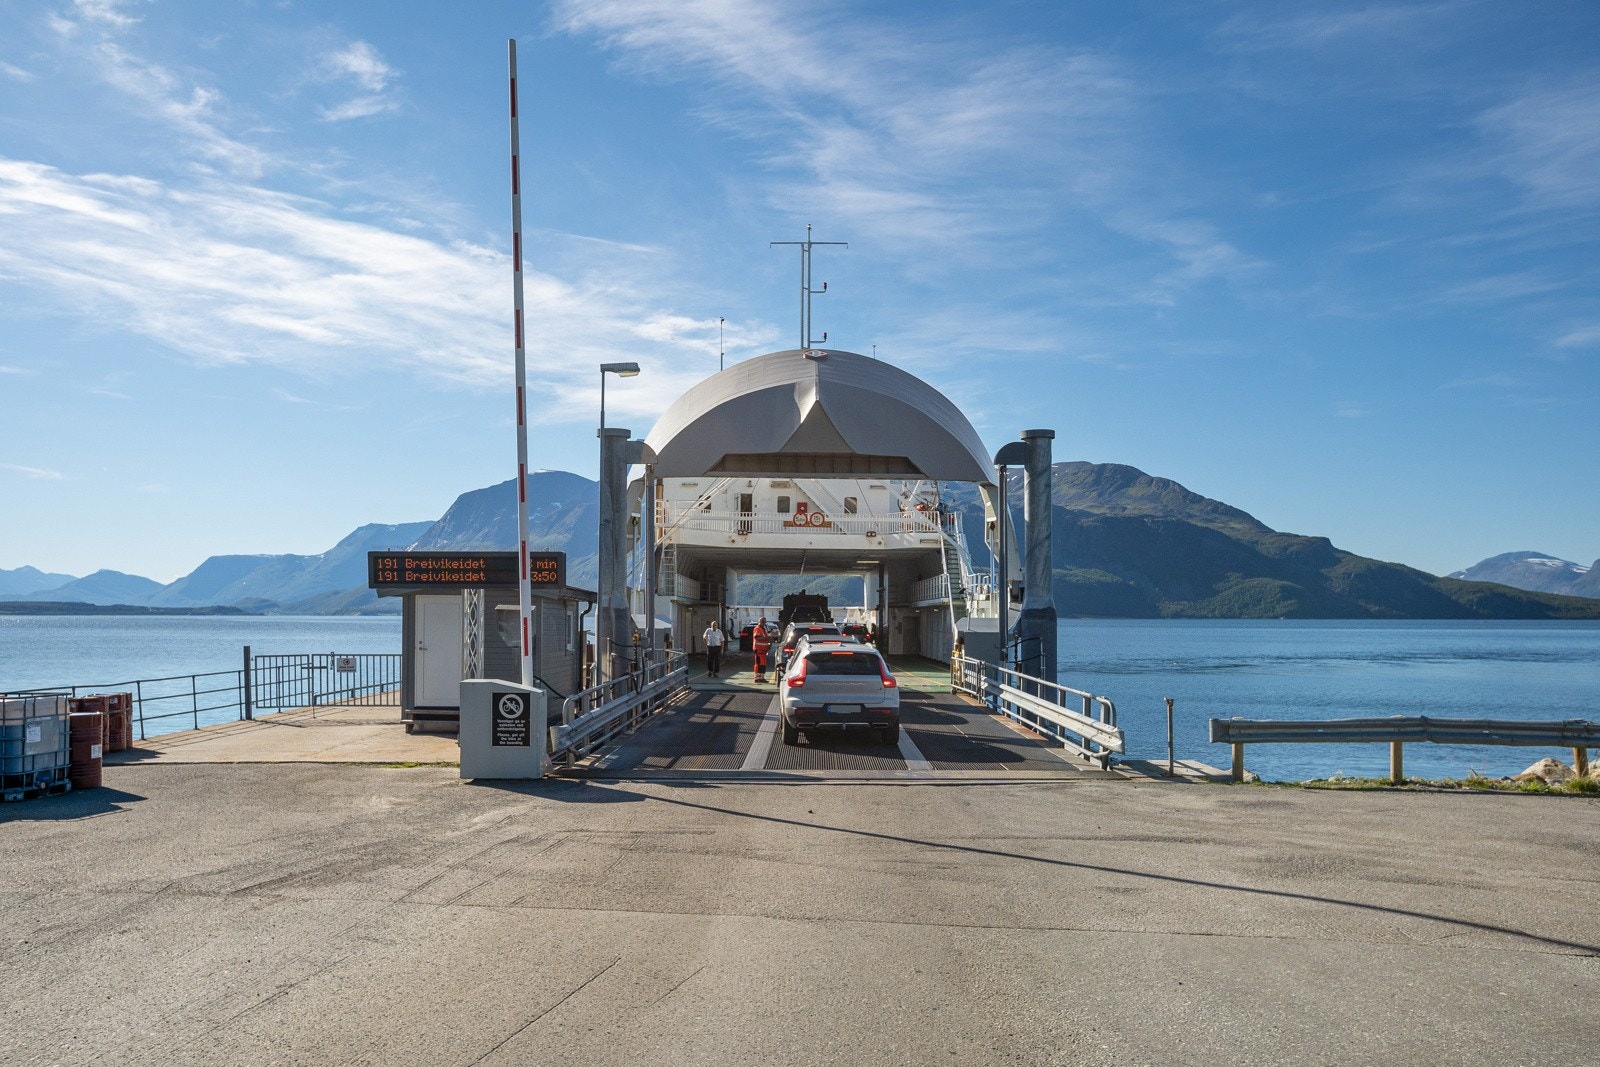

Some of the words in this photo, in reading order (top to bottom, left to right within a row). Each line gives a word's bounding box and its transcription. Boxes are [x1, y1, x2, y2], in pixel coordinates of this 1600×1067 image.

[378, 558, 398, 568] 191
[405, 558, 486, 568] Breivikeidet
[536, 558, 557, 568] min
[378, 571, 398, 581] 191
[405, 571, 486, 581] Breivikeidet
